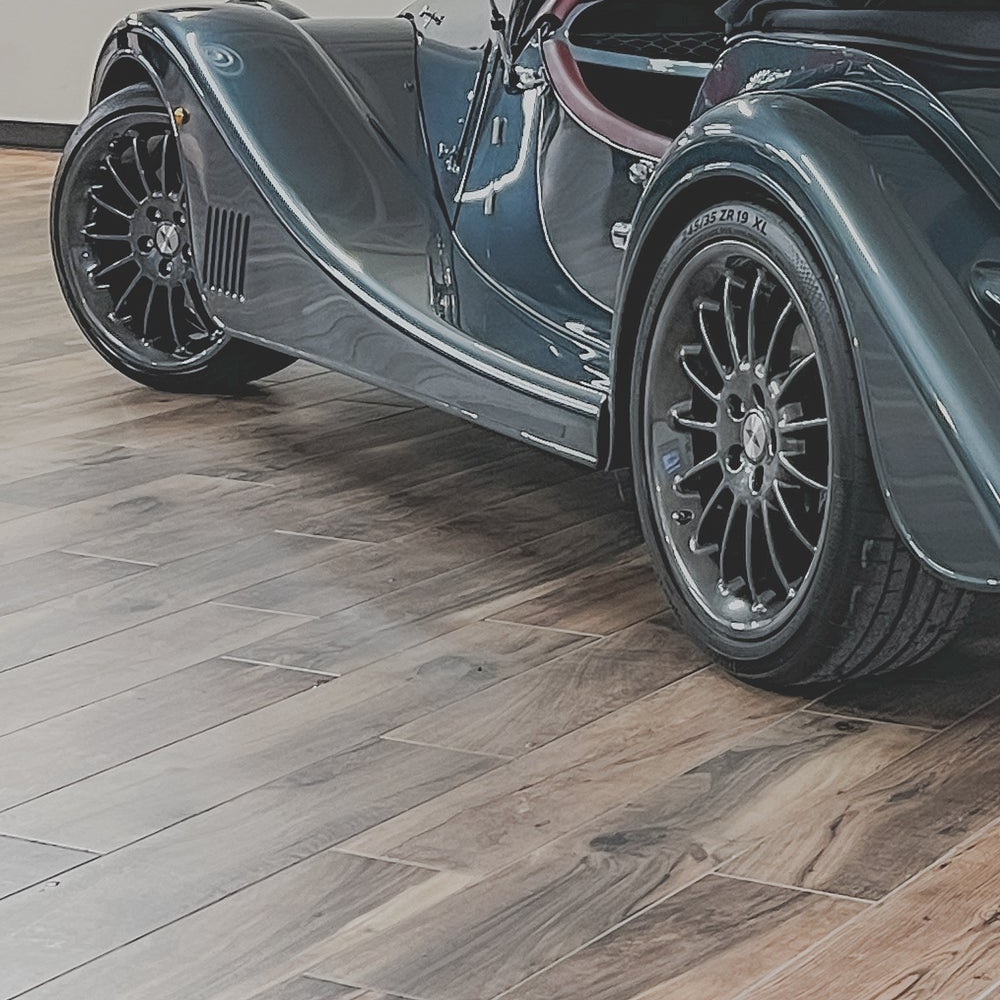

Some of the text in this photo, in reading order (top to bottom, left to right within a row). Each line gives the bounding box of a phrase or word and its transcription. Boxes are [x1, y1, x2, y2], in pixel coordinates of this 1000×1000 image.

[719, 209, 734, 222] ZR
[737, 210, 749, 224] 19
[752, 216, 767, 236] XL
